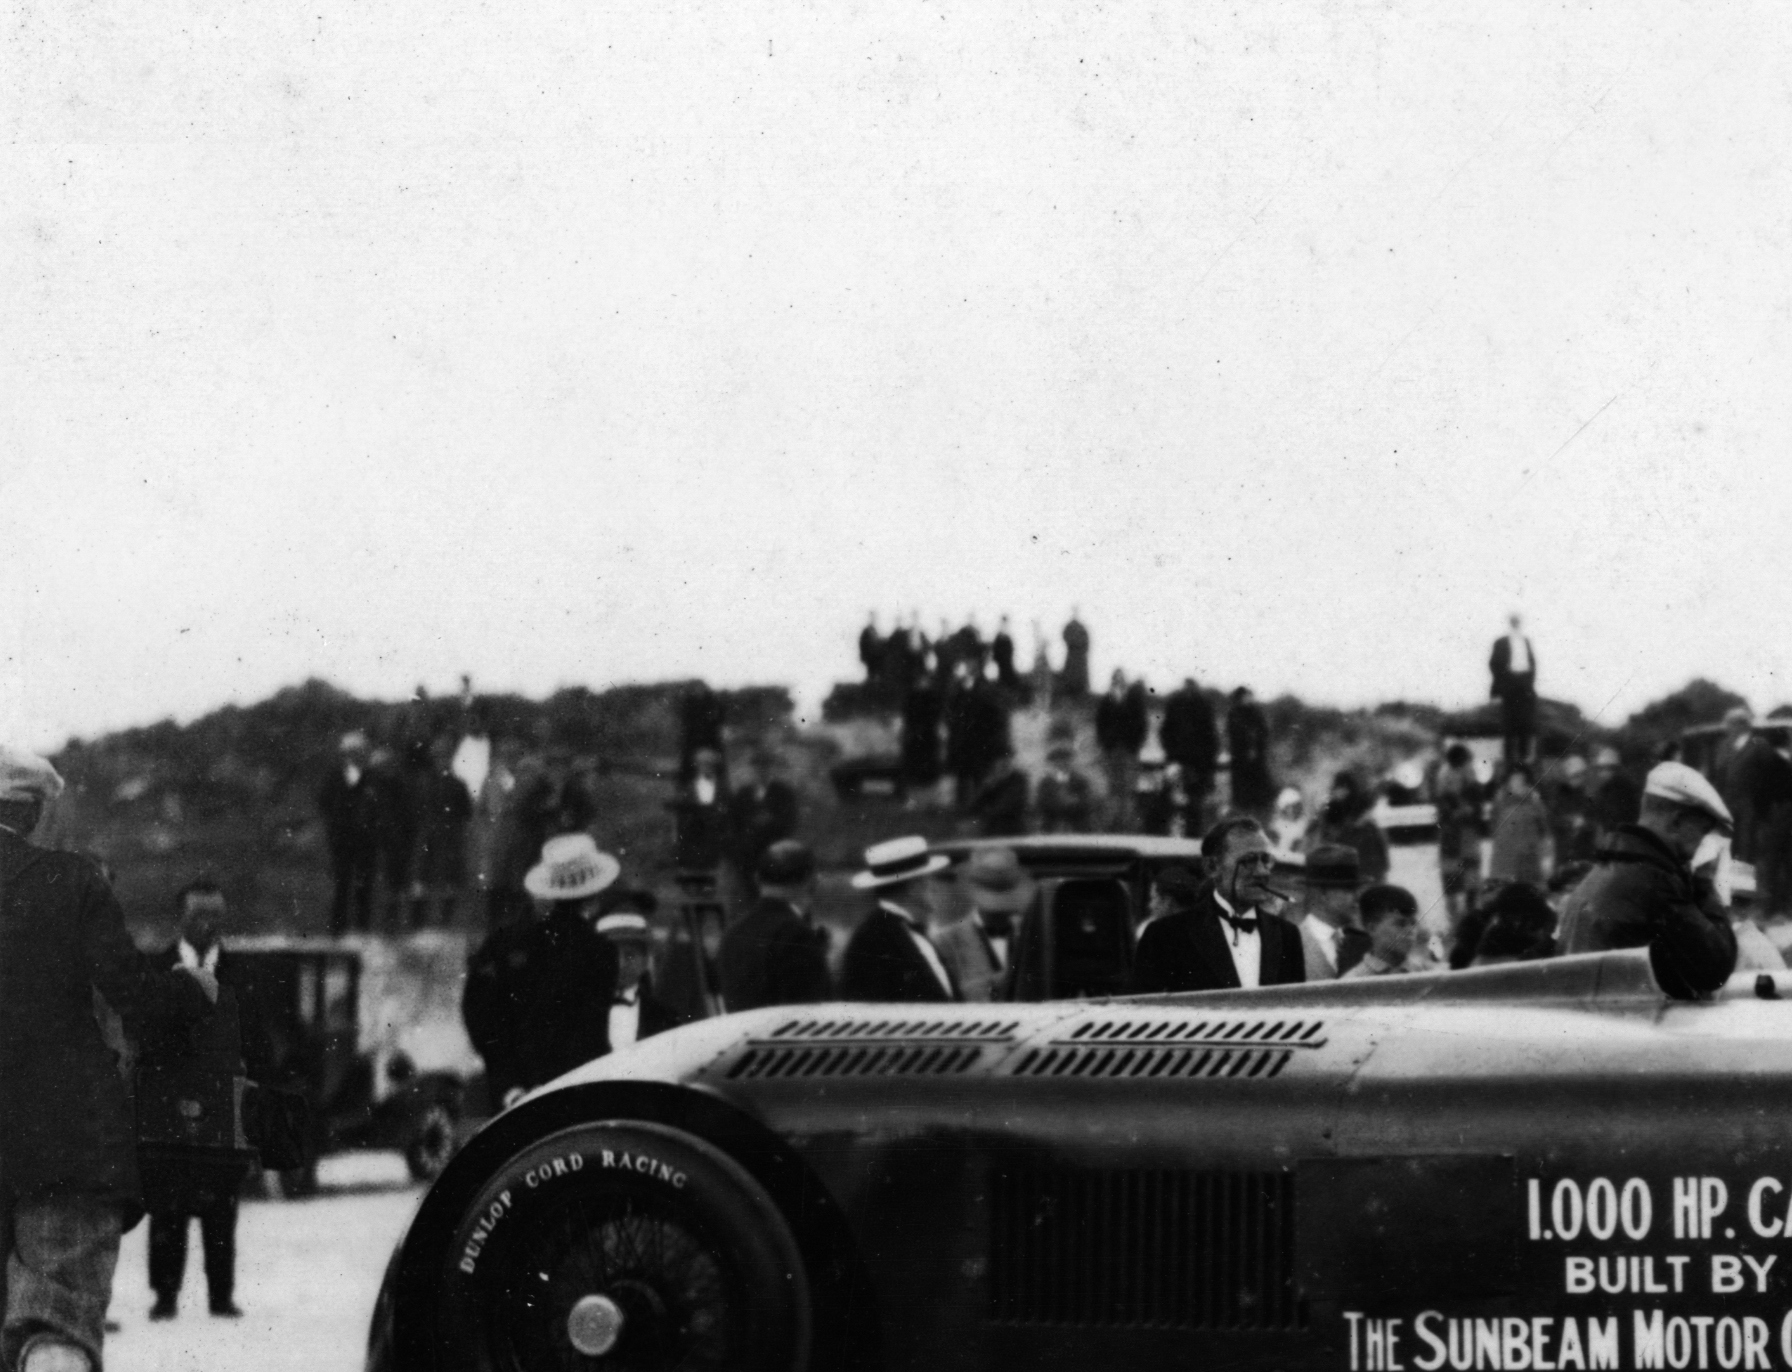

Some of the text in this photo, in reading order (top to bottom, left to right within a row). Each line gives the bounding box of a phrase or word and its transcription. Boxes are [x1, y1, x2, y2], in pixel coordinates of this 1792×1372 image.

[459, 1149, 687, 1274] DUNLOP CORD RACING
[1528, 1177, 1653, 1240] 1.000
[1673, 1176, 1736, 1239] HP.
[1565, 1254, 1778, 1294] BUILT BY
[1343, 1311, 1404, 1372] THE
[1413, 1310, 1619, 1371] SUNBEAM
[1633, 1309, 1771, 1370] MOTOR
